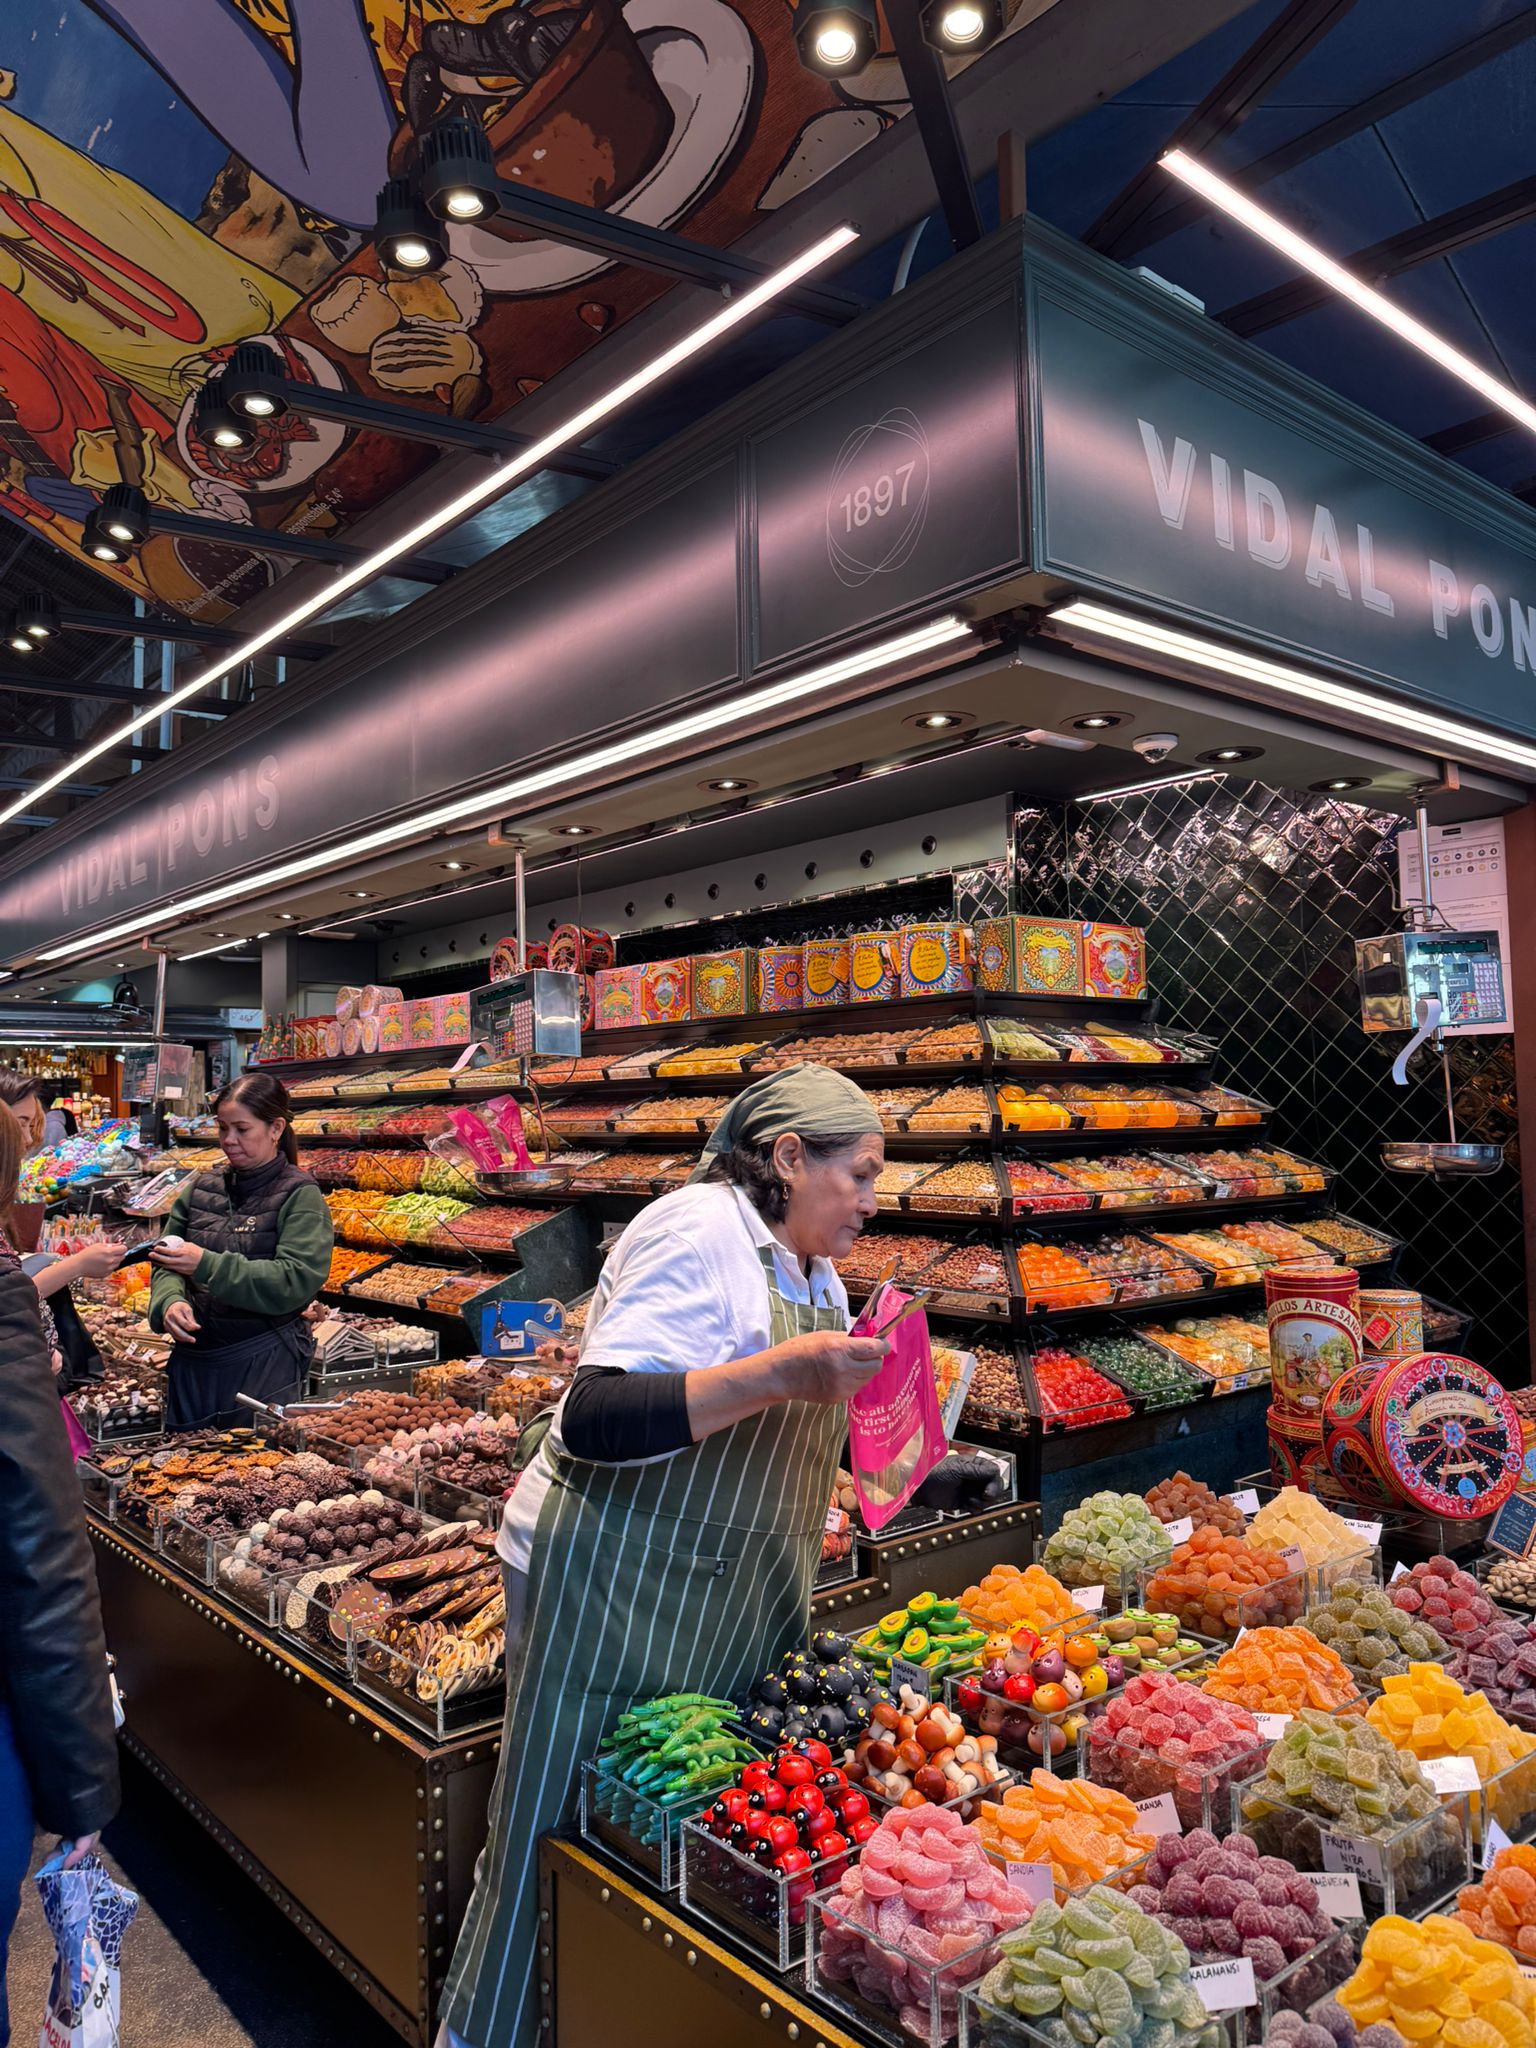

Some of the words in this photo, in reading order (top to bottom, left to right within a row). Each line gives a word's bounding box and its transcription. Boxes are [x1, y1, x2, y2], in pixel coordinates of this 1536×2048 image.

[840, 460, 916, 533] 1897
[1137, 418, 1395, 618] VIDAL
[1428, 558, 1536, 677] PON
[58, 824, 148, 916] VIDAL
[168, 754, 281, 872] PONS
[869, 1405, 886, 1417] all
[864, 1414, 891, 1427] first
[859, 1426, 871, 1436] is
[873, 1426, 886, 1436] to
[1136, 1799, 1163, 1813] ARANJA
[1325, 1835, 1356, 1852] FRUTA
[1008, 1863, 1034, 1875] SANDIA
[1189, 1962, 1240, 1981] KALAMANSI
